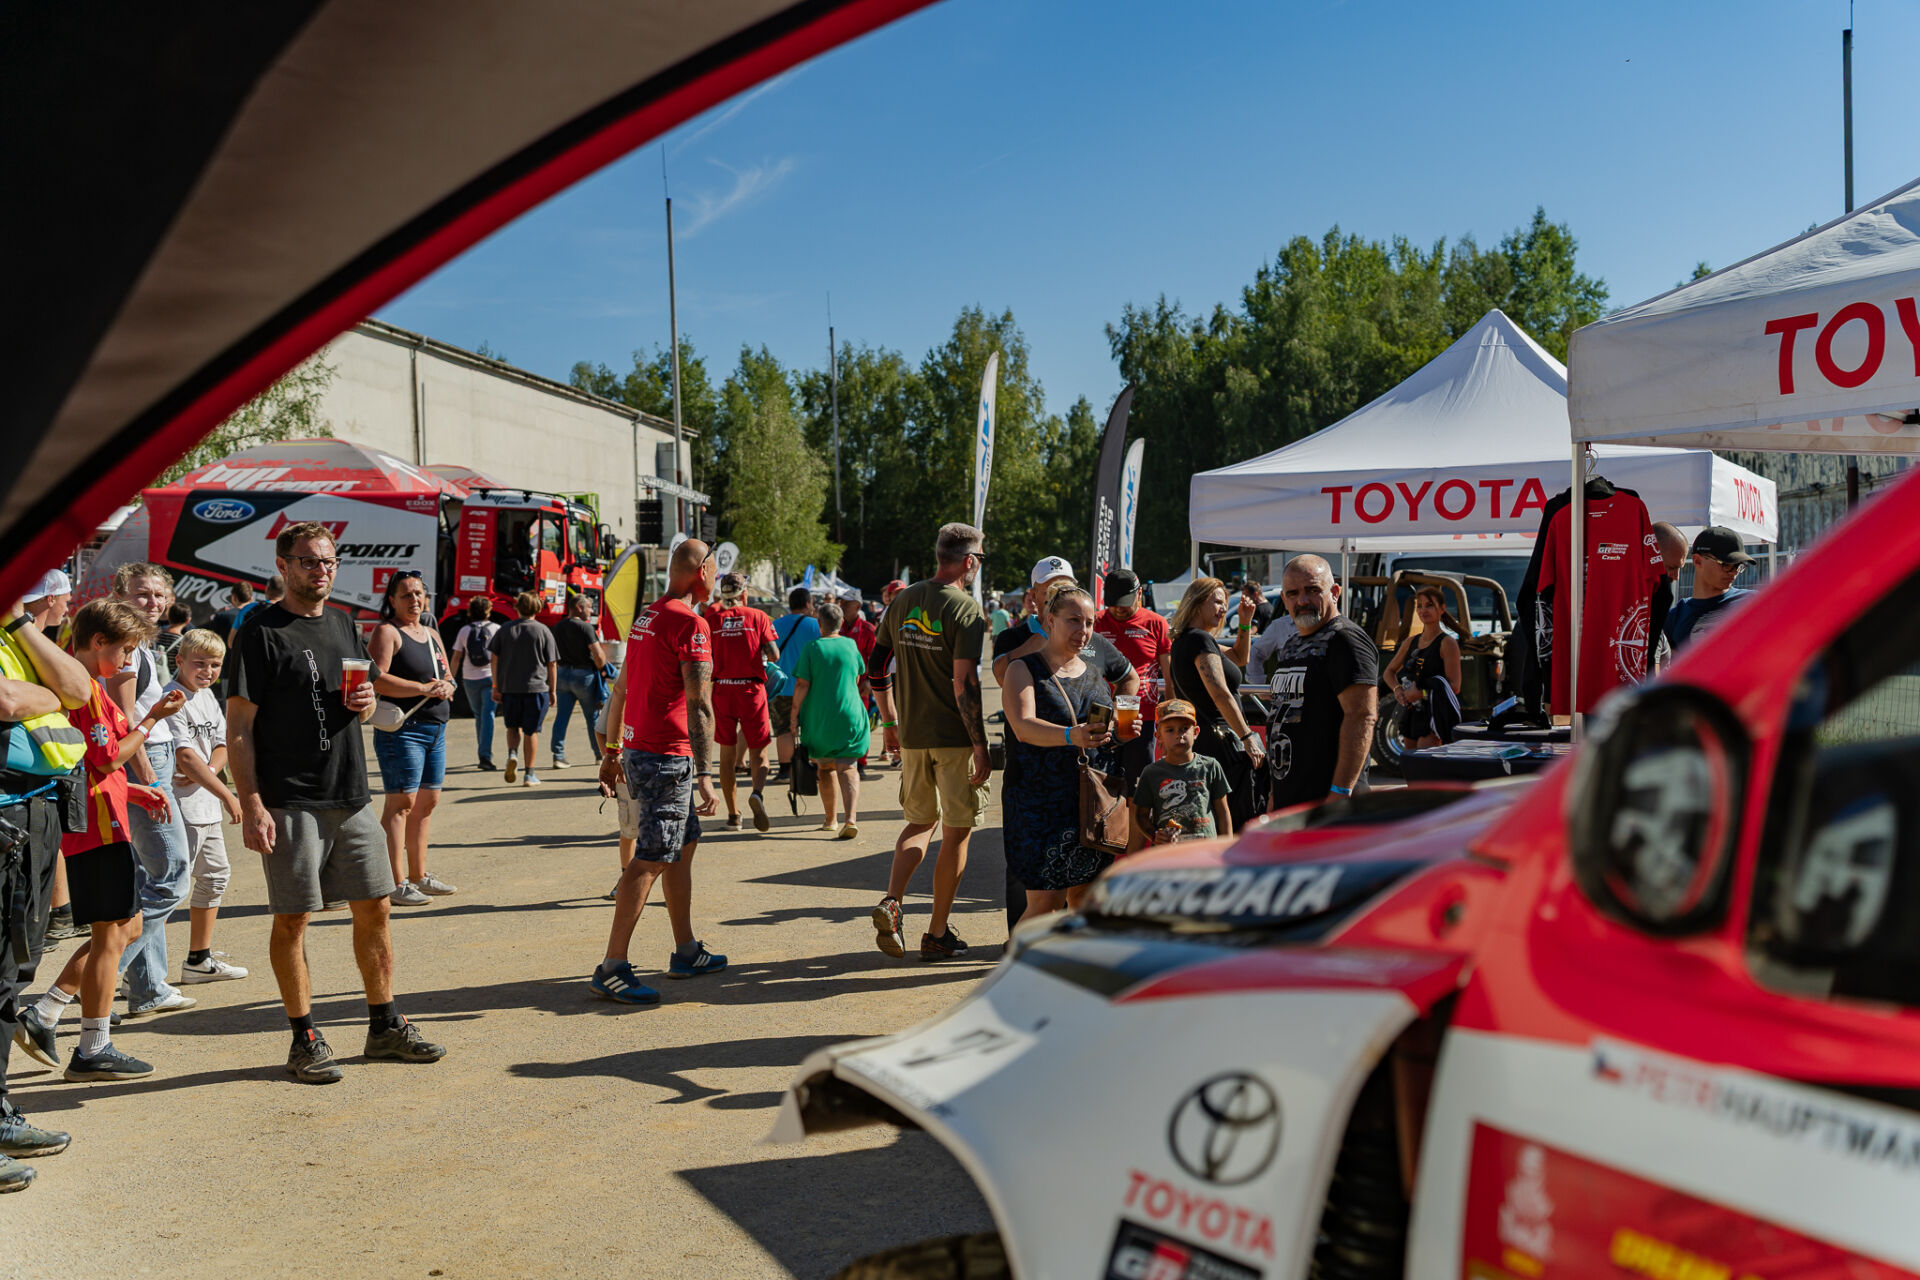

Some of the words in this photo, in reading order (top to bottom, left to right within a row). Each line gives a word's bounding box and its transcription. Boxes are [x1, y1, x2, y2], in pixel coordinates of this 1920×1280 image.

[203, 502, 243, 519] Ford
[1321, 478, 1547, 524] TOYOTA
[1733, 478, 1765, 526] TOYOTA
[336, 544, 420, 558] PORTS
[1096, 496, 1106, 570] TOYOTA
[1100, 866, 1345, 916] MUSICDATA
[1124, 1168, 1275, 1260] TOYOTA
